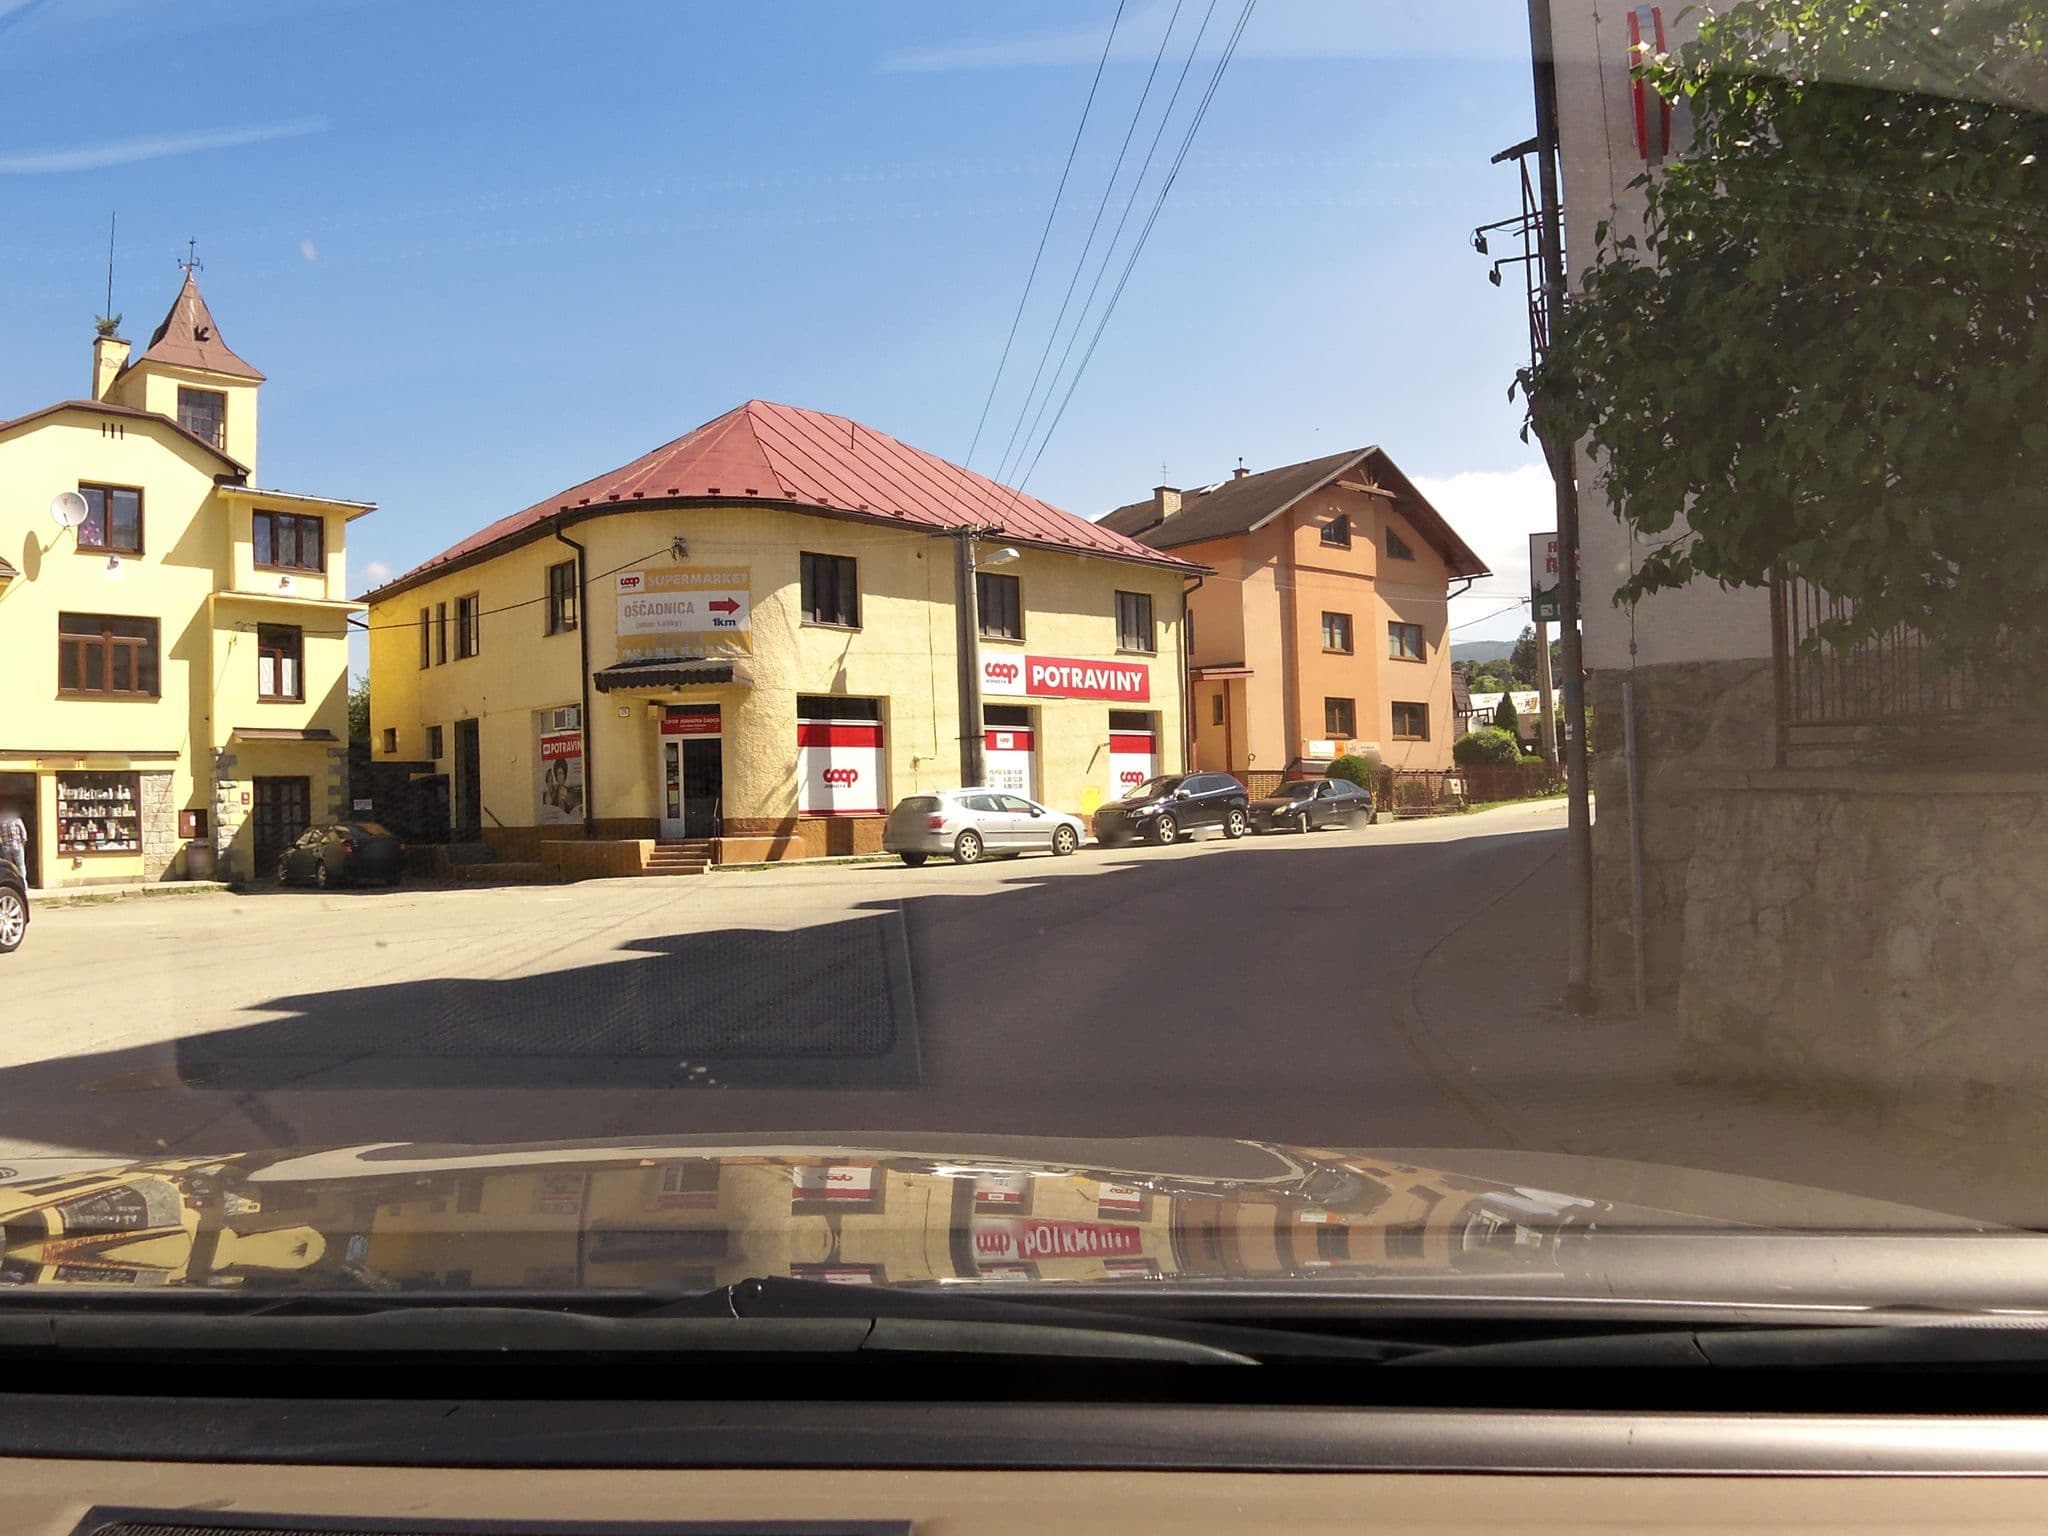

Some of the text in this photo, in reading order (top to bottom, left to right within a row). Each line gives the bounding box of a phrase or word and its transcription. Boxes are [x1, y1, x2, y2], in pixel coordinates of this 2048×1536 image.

[620, 573, 748, 588] coop SUPERMARKET
[624, 601, 695, 618] OŠČADNICA
[712, 618, 736, 627] 1km
[984, 662, 1143, 692] coop POTRAVINY
[550, 740, 582, 754] POTRAVIN
[823, 769, 858, 788] coop
[1120, 771, 1144, 784] coop
